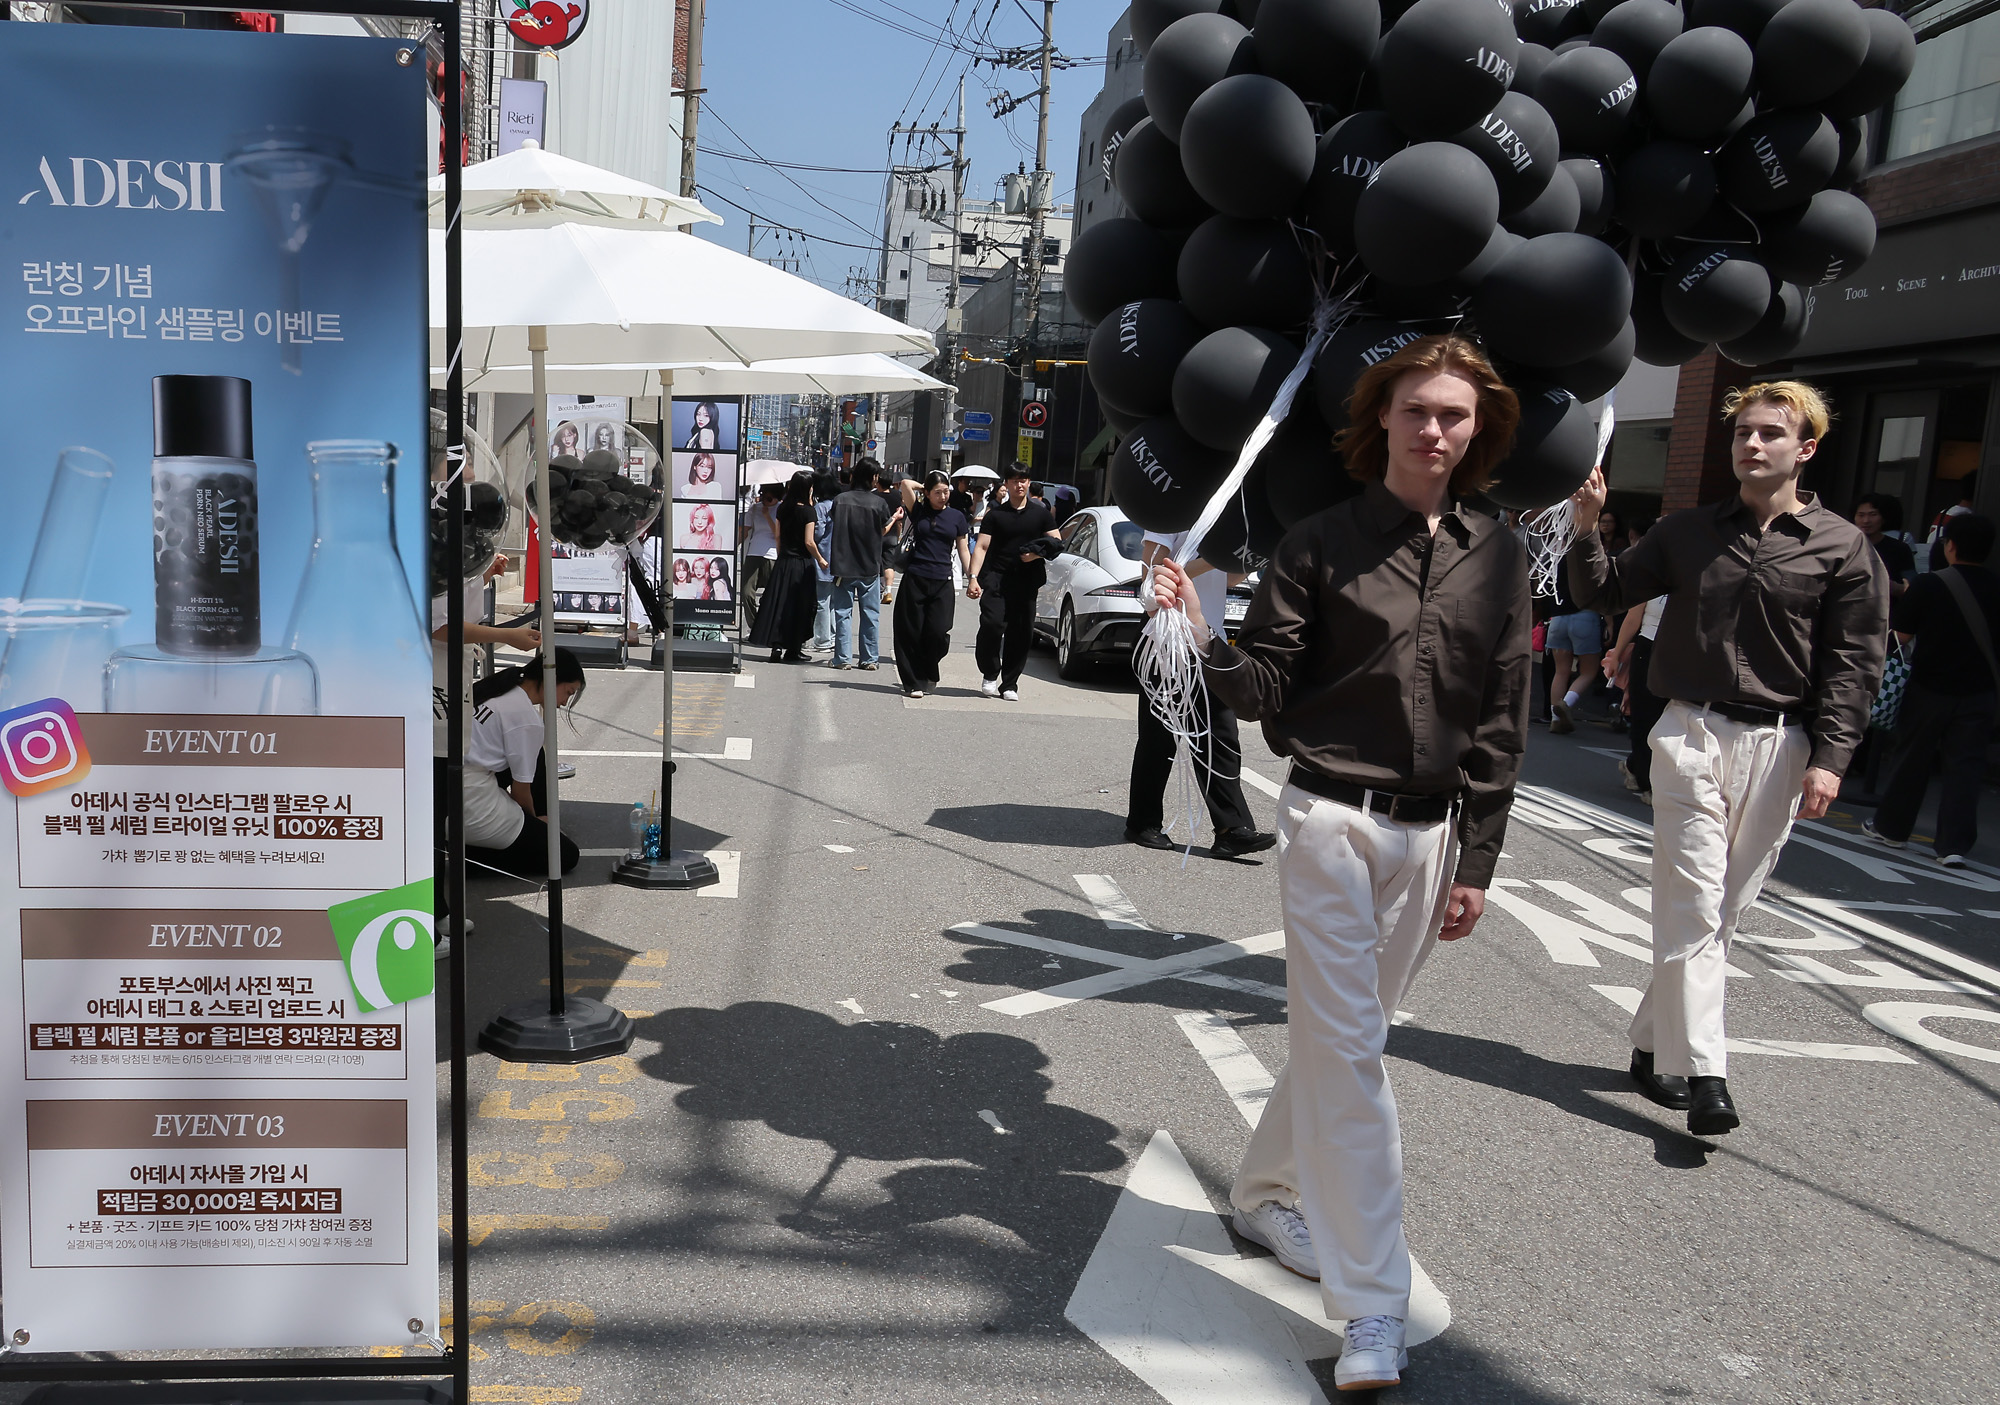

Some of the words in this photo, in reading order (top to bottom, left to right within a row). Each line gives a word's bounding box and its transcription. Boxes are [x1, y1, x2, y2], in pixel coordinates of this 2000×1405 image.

[507, 111, 534, 125] Rieti
[1749, 135, 1789, 190] ADESII
[19, 155, 225, 212] ADESII
[23, 261, 83, 297] 런칭
[93, 264, 152, 298] 기념
[25, 305, 146, 339] 오프라인
[155, 307, 244, 342] 샘플링
[255, 310, 344, 343] 이벤트
[1119, 301, 1142, 357] ADESII
[1130, 436, 1181, 492] ADESII
[205, 489, 213, 514] BLACK
[218, 490, 239, 573] ADESII
[144, 729, 247, 754] EVENT
[250, 731, 277, 754] 01
[71, 792, 128, 813] 아데시
[133, 792, 171, 813] 공식
[175, 792, 269, 813] 인스타그램
[274, 792, 329, 813] 팔로우
[333, 792, 352, 813] 시
[43, 815, 81, 836] 블랙
[87, 815, 104, 836] 펄
[110, 815, 147, 836] 세럼
[152, 815, 228, 836] 트라이얼
[232, 815, 269, 836] 유닛
[278, 818, 337, 836] 100%
[342, 817, 381, 837] 증정
[102, 849, 128, 864] 가챠
[134, 849, 172, 864] 뽑기로
[175, 849, 187, 864] 꽝
[191, 849, 215, 864] 없는
[219, 849, 256, 864] 혜택을
[259, 849, 325, 864] 누려보세요!
[148, 924, 250, 947] EVENT
[253, 926, 282, 948] 02
[119, 976, 231, 995] 포토부스에서
[235, 976, 271, 995] 사진
[276, 976, 313, 995] 찍고
[87, 1000, 144, 1019] 아데시
[148, 1000, 186, 1019] 태그
[190, 1001, 204, 1017] &
[208, 1000, 262, 1019] 스토리
[268, 1000, 322, 1019] 업로드
[327, 1000, 345, 1019] 시
[36, 1026, 73, 1047] 블랙
[78, 1026, 97, 1047] 펄
[102, 1026, 139, 1047] 세럼
[144, 1026, 180, 1047] 본품
[184, 1030, 205, 1045] or
[210, 1026, 282, 1047] 올리브영
[288, 1026, 355, 1047] 3만원권
[360, 1026, 397, 1047] 증정
[70, 1054, 98, 1066] 추첨을
[101, 1054, 120, 1066] 통해
[122, 1054, 149, 1066] 당첨된
[183, 1054, 202, 1066] 6/15
[205, 1054, 251, 1066] 인스타그램
[254, 1054, 272, 1066] 개별
[275, 1054, 292, 1066] 연락
[295, 1054, 325, 1066] 드려요!
[327, 1054, 340, 1066] (각
[342, 1054, 364, 1066] 10명)
[153, 1114, 253, 1138] EVENT
[256, 1115, 284, 1138] 03
[130, 1165, 185, 1184] 아데시
[190, 1165, 244, 1184] 자사몰
[249, 1165, 285, 1184] 가입
[291, 1165, 308, 1184] 시
[102, 1191, 157, 1213] 적립금
[162, 1191, 256, 1213] 30,000원
[260, 1191, 296, 1213] 즉시
[301, 1191, 337, 1213] 지급
[78, 1219, 103, 1233] 본품
[113, 1219, 137, 1233] 굿즈
[148, 1219, 183, 1233] 기프트
[187, 1219, 211, 1233] 카드
[215, 1221, 250, 1231] 100%
[254, 1219, 278, 1233] 당첨
[282, 1219, 306, 1233] 가챠
[310, 1219, 345, 1233] 참여권
[349, 1219, 372, 1233] 증정
[67, 1237, 114, 1250] 실결제금액
[115, 1237, 136, 1250] 20%
[139, 1237, 157, 1250] 이내
[160, 1237, 178, 1250] 사용
[181, 1237, 229, 1250] 가능(배송비
[232, 1237, 256, 1250] 제외),
[258, 1237, 286, 1250] 미소진
[289, 1237, 296, 1250] 시
[299, 1237, 321, 1250] 90일
[323, 1237, 332, 1250] 후
[334, 1237, 352, 1250] 자동
[355, 1237, 373, 1250] 소멸
